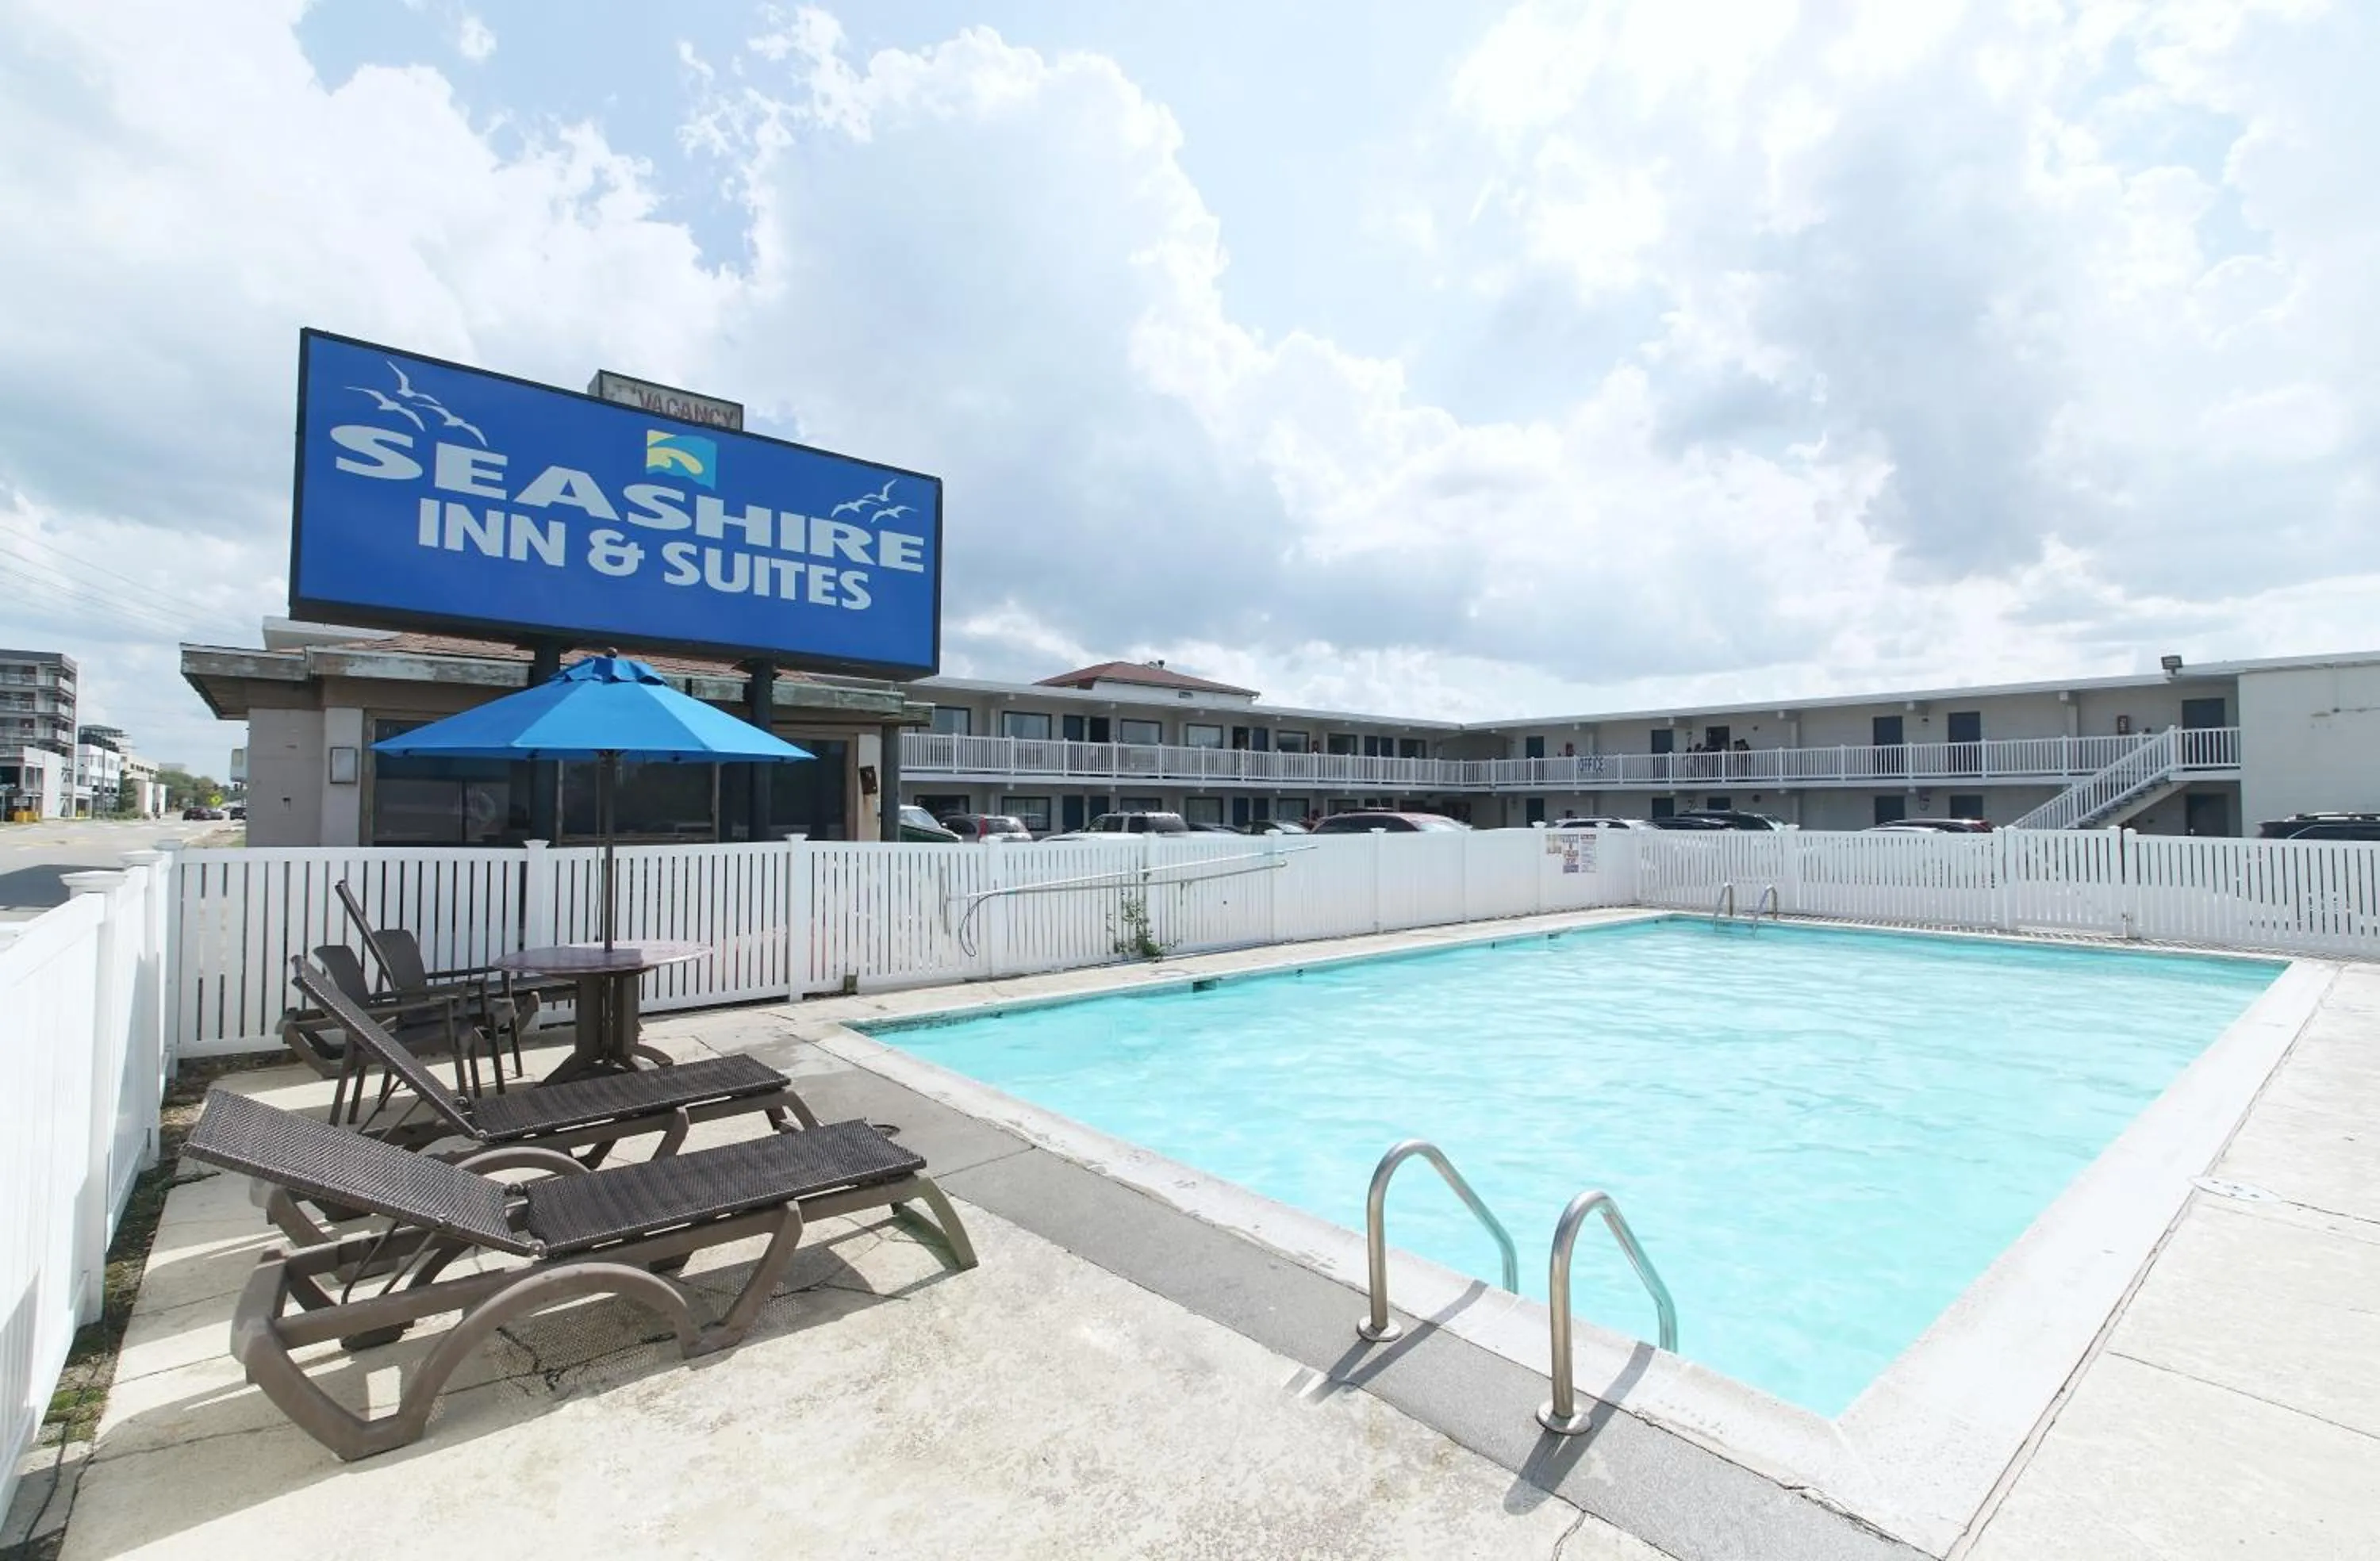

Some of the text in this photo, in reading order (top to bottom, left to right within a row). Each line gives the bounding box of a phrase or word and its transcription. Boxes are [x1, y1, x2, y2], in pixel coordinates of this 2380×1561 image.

[639, 389, 734, 426] VACANCY
[330, 425, 924, 573] SEASHIRE
[418, 499, 872, 610] INN & SUITES
